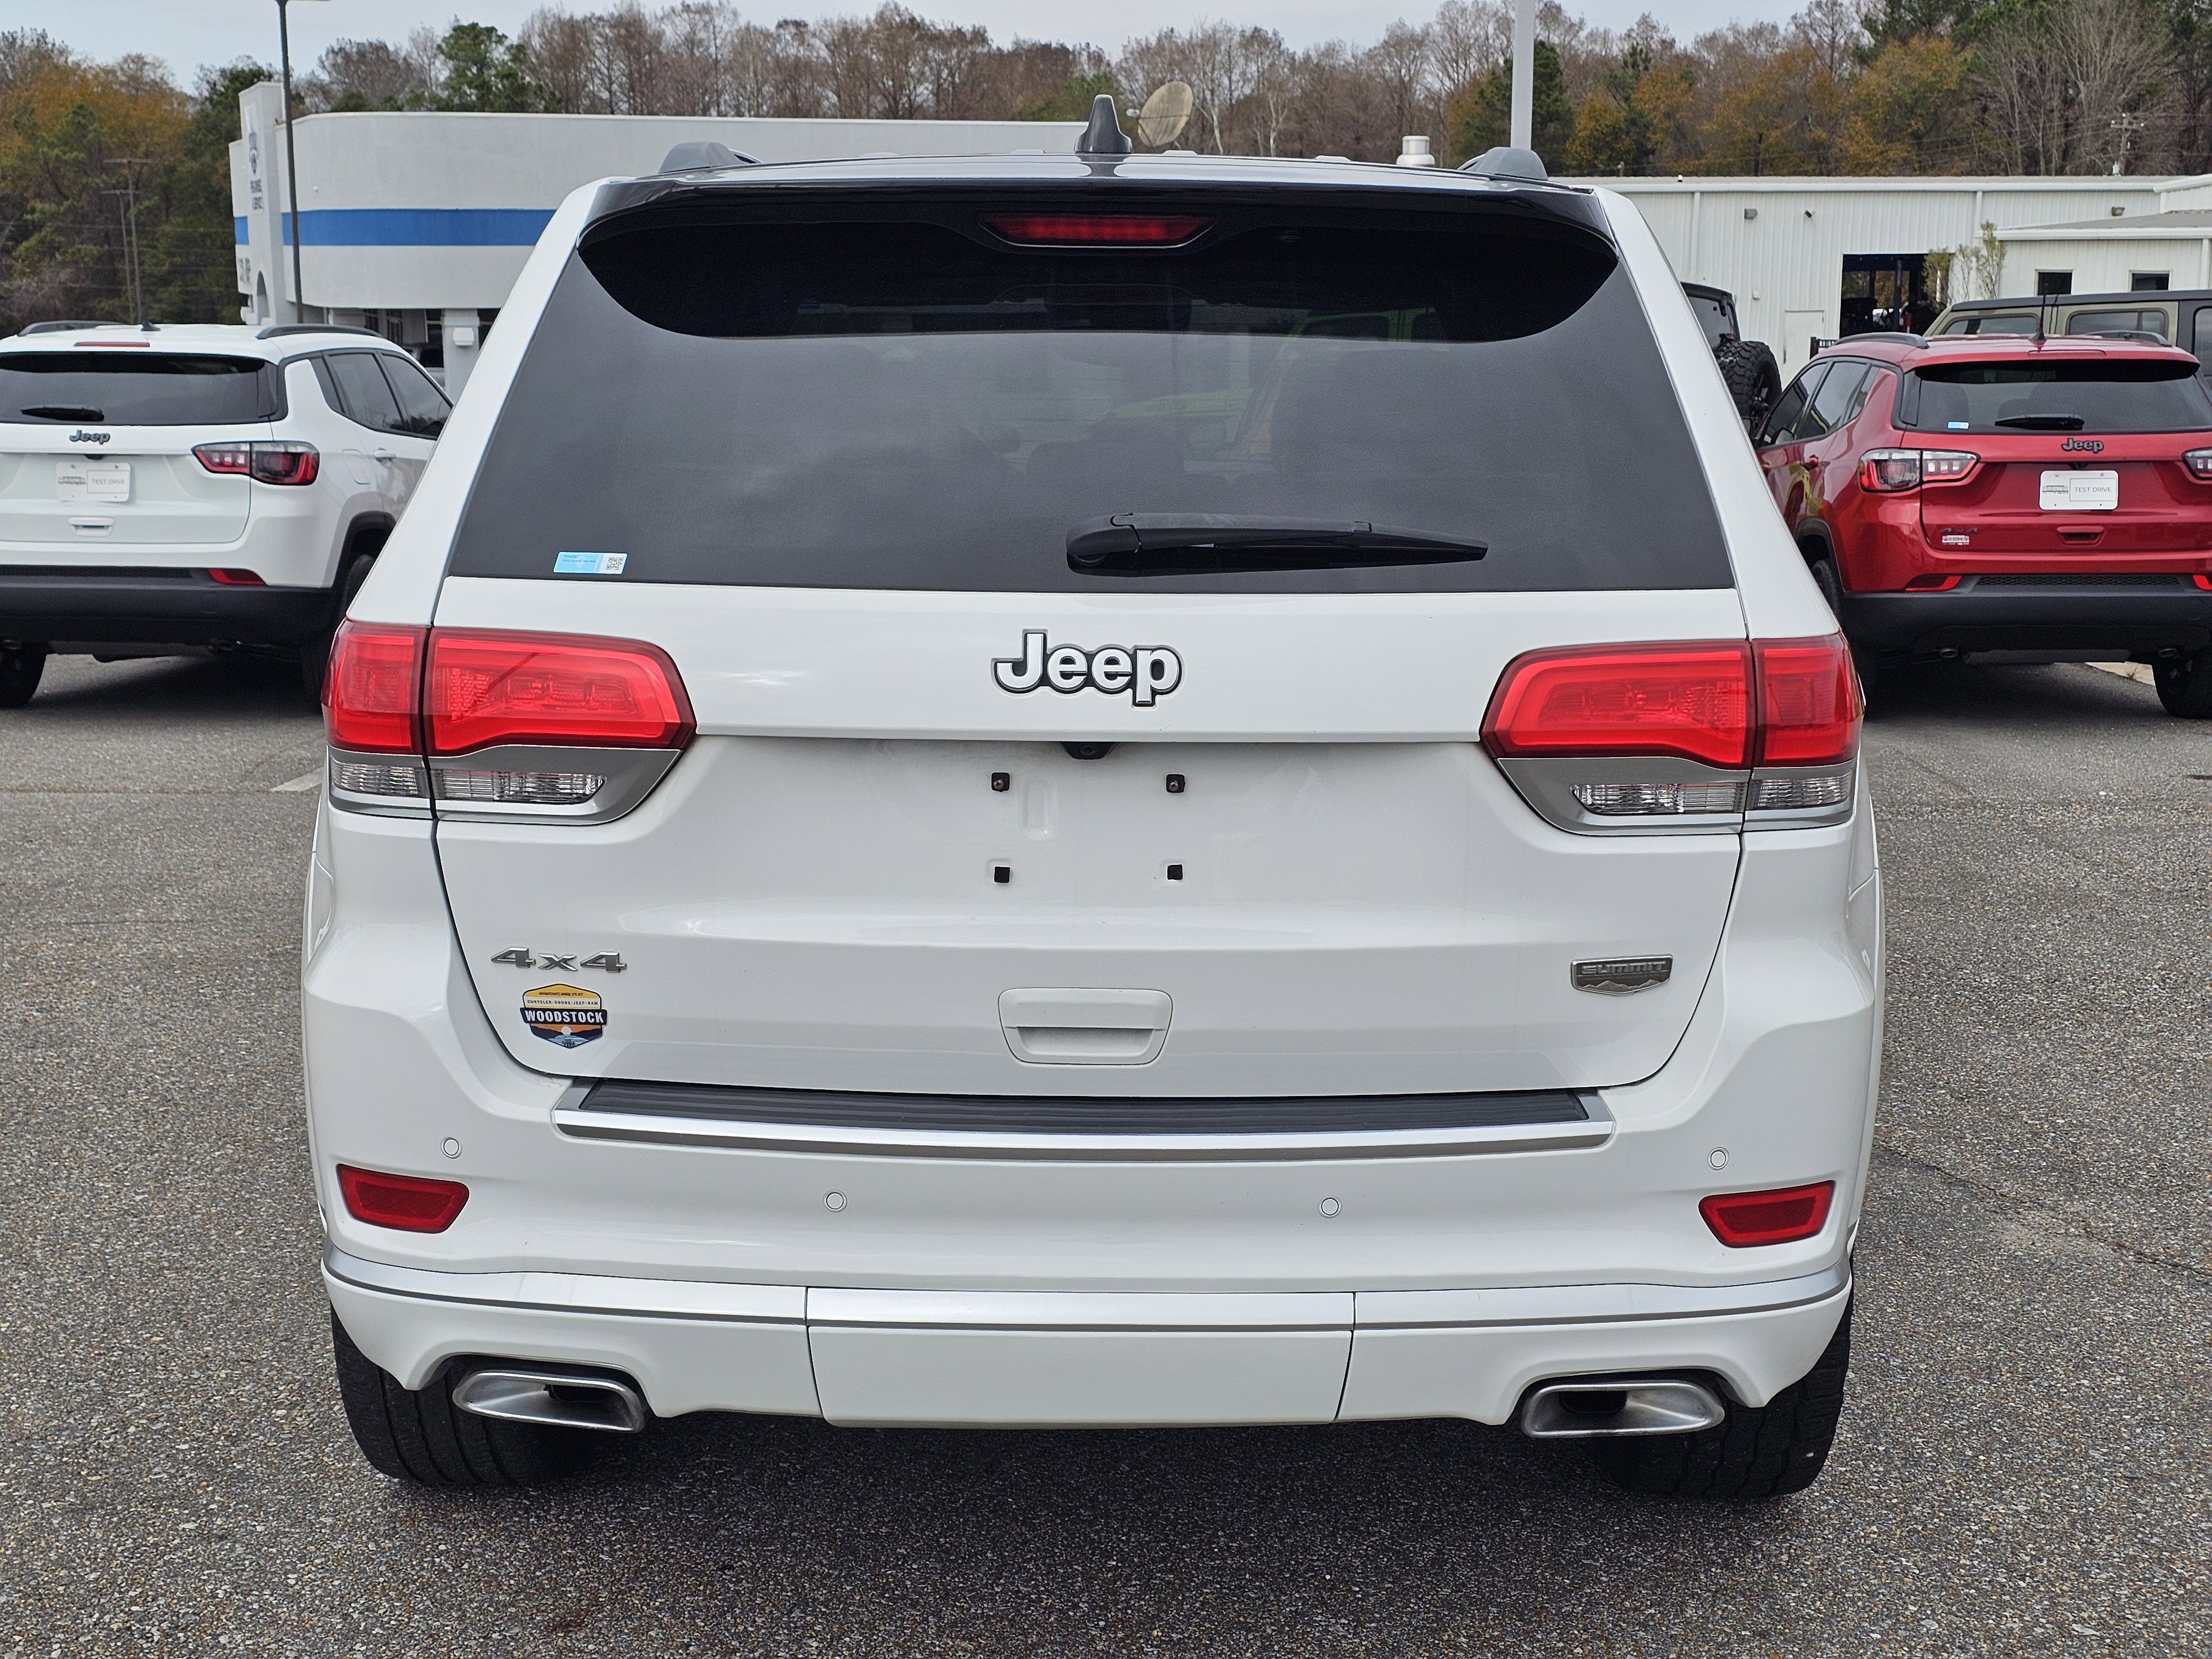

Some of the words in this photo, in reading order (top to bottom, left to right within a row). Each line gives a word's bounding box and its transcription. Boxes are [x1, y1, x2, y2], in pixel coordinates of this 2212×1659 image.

[69, 429, 111, 445] Jeep
[2061, 438, 2105, 453] Jeep
[993, 629, 1185, 708] Jeep
[491, 946, 627, 973] 4x4
[525, 1010, 604, 1023] WOODSTOCK
